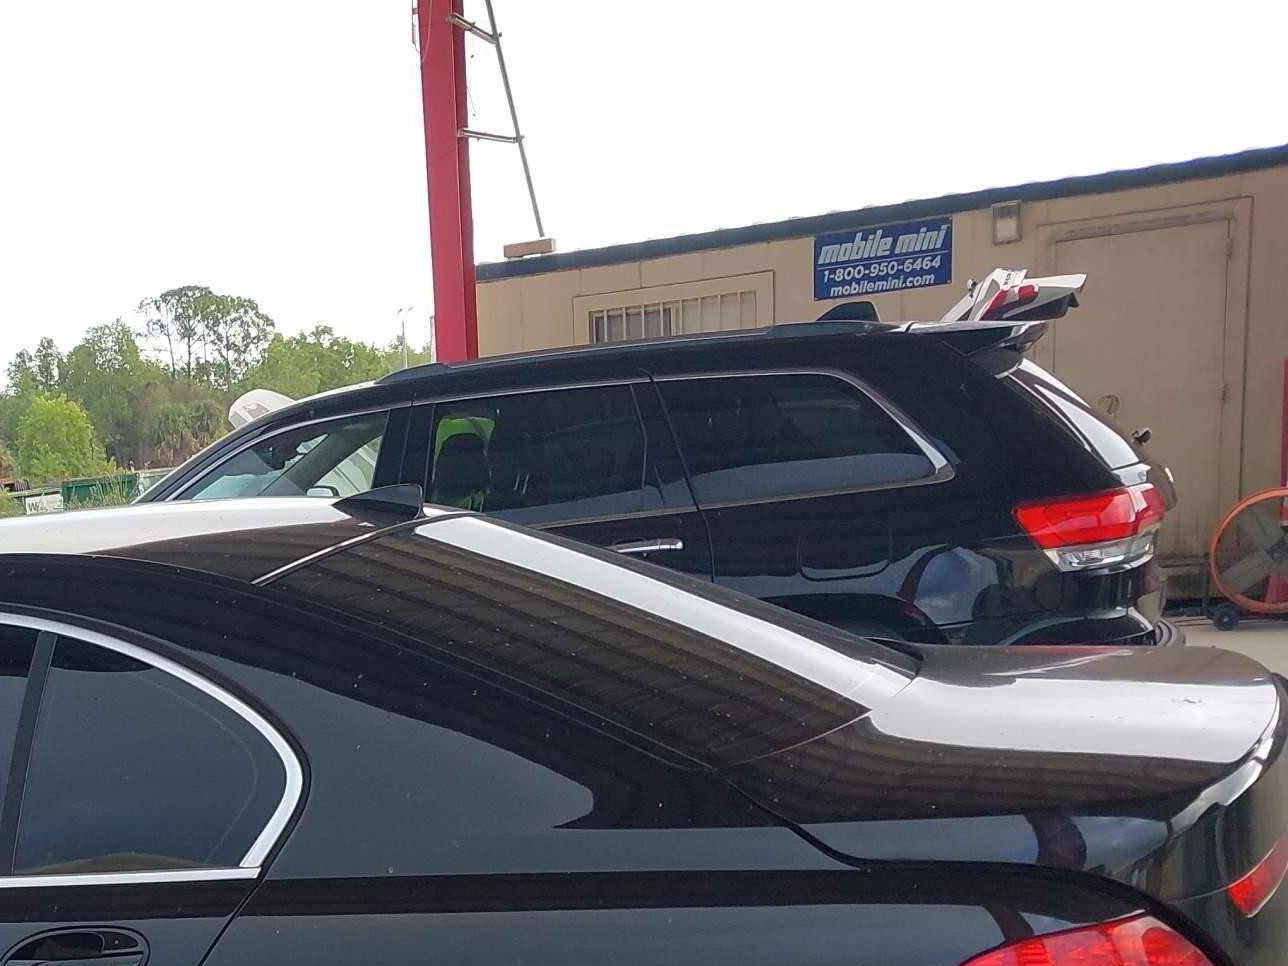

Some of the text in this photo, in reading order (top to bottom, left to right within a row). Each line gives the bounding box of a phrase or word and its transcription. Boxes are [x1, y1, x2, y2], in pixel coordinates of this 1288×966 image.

[818, 224, 948, 264] mobile mini
[823, 255, 941, 283] 1-800-950-6464
[830, 274, 935, 297] mobilemini.com
